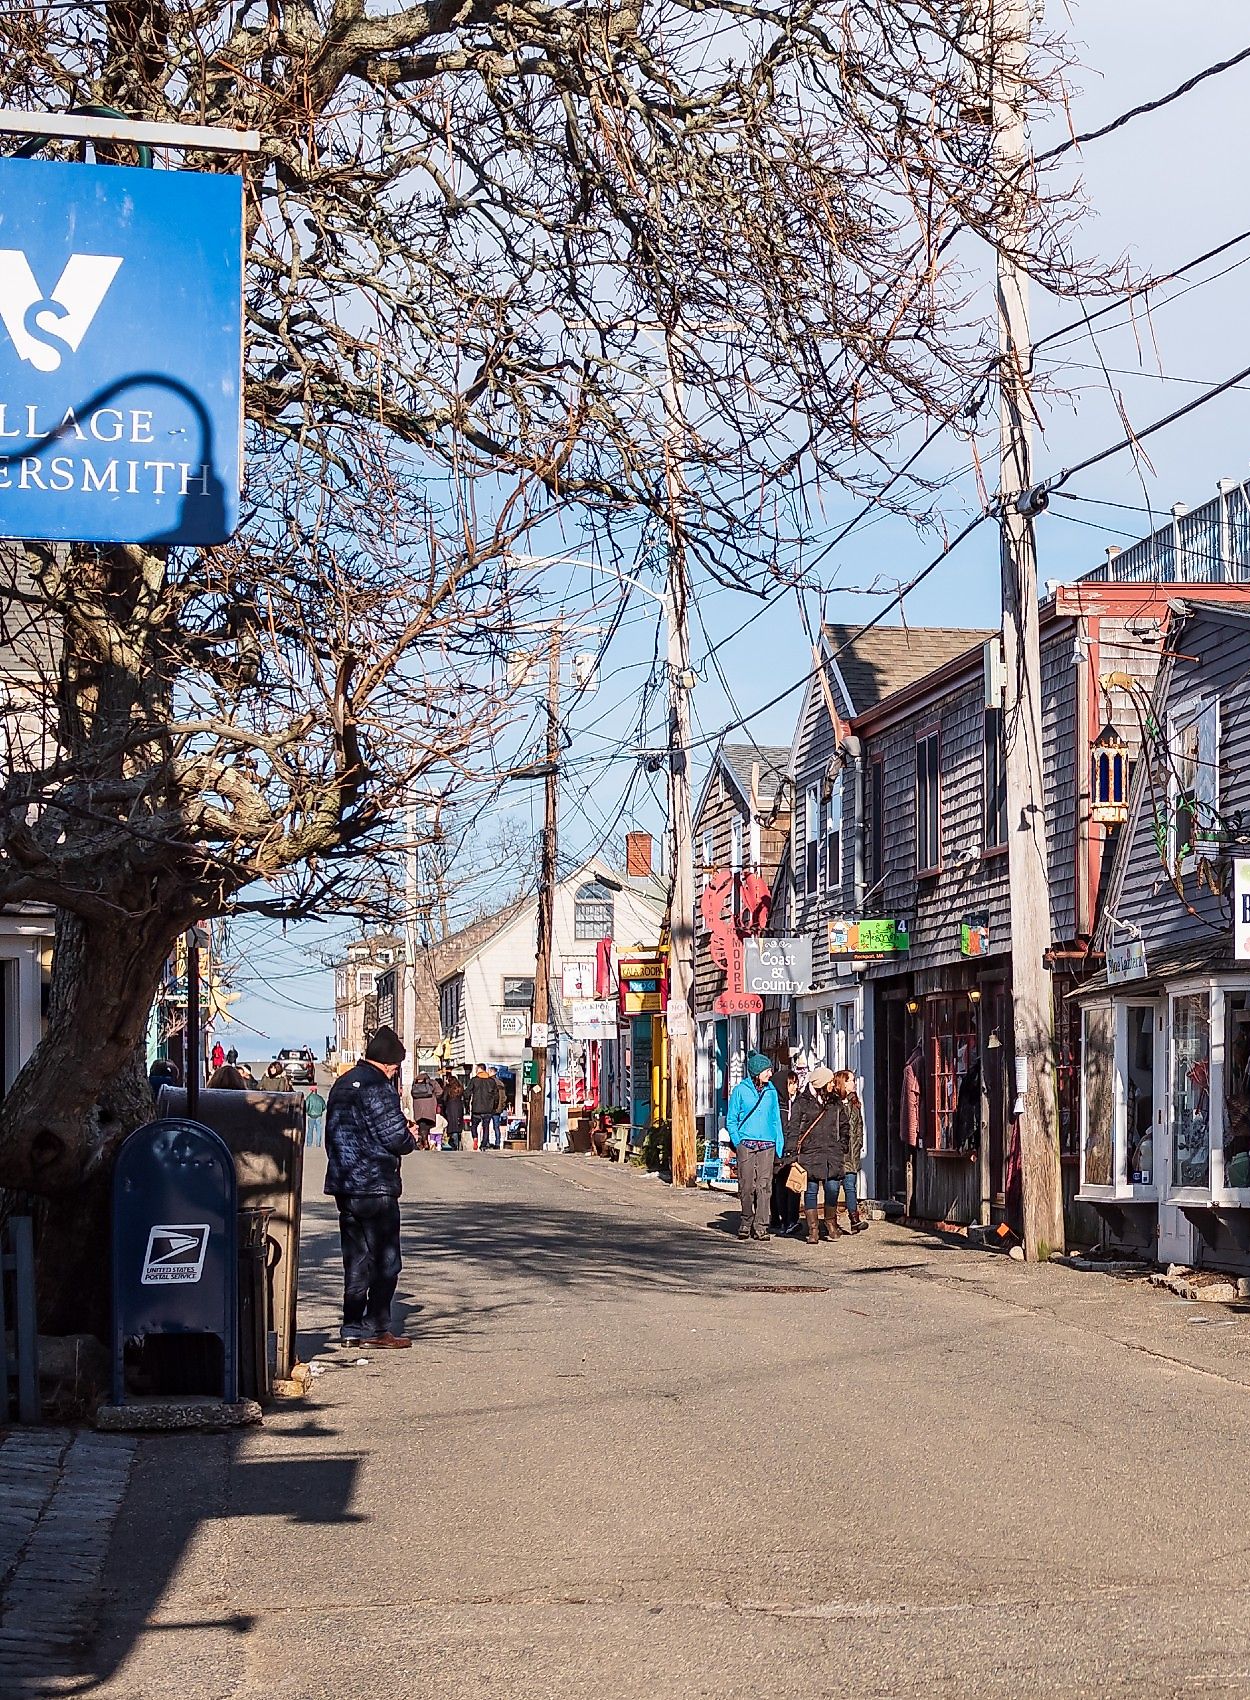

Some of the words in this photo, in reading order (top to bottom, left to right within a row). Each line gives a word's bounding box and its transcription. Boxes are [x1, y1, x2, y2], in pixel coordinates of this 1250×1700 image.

[897, 919, 907, 933] 4
[732, 937, 742, 994] MOORE
[760, 951, 796, 966] Coast
[771, 967, 785, 979] &
[751, 977, 805, 993] Country
[738, 999, 762, 1010] 6696
